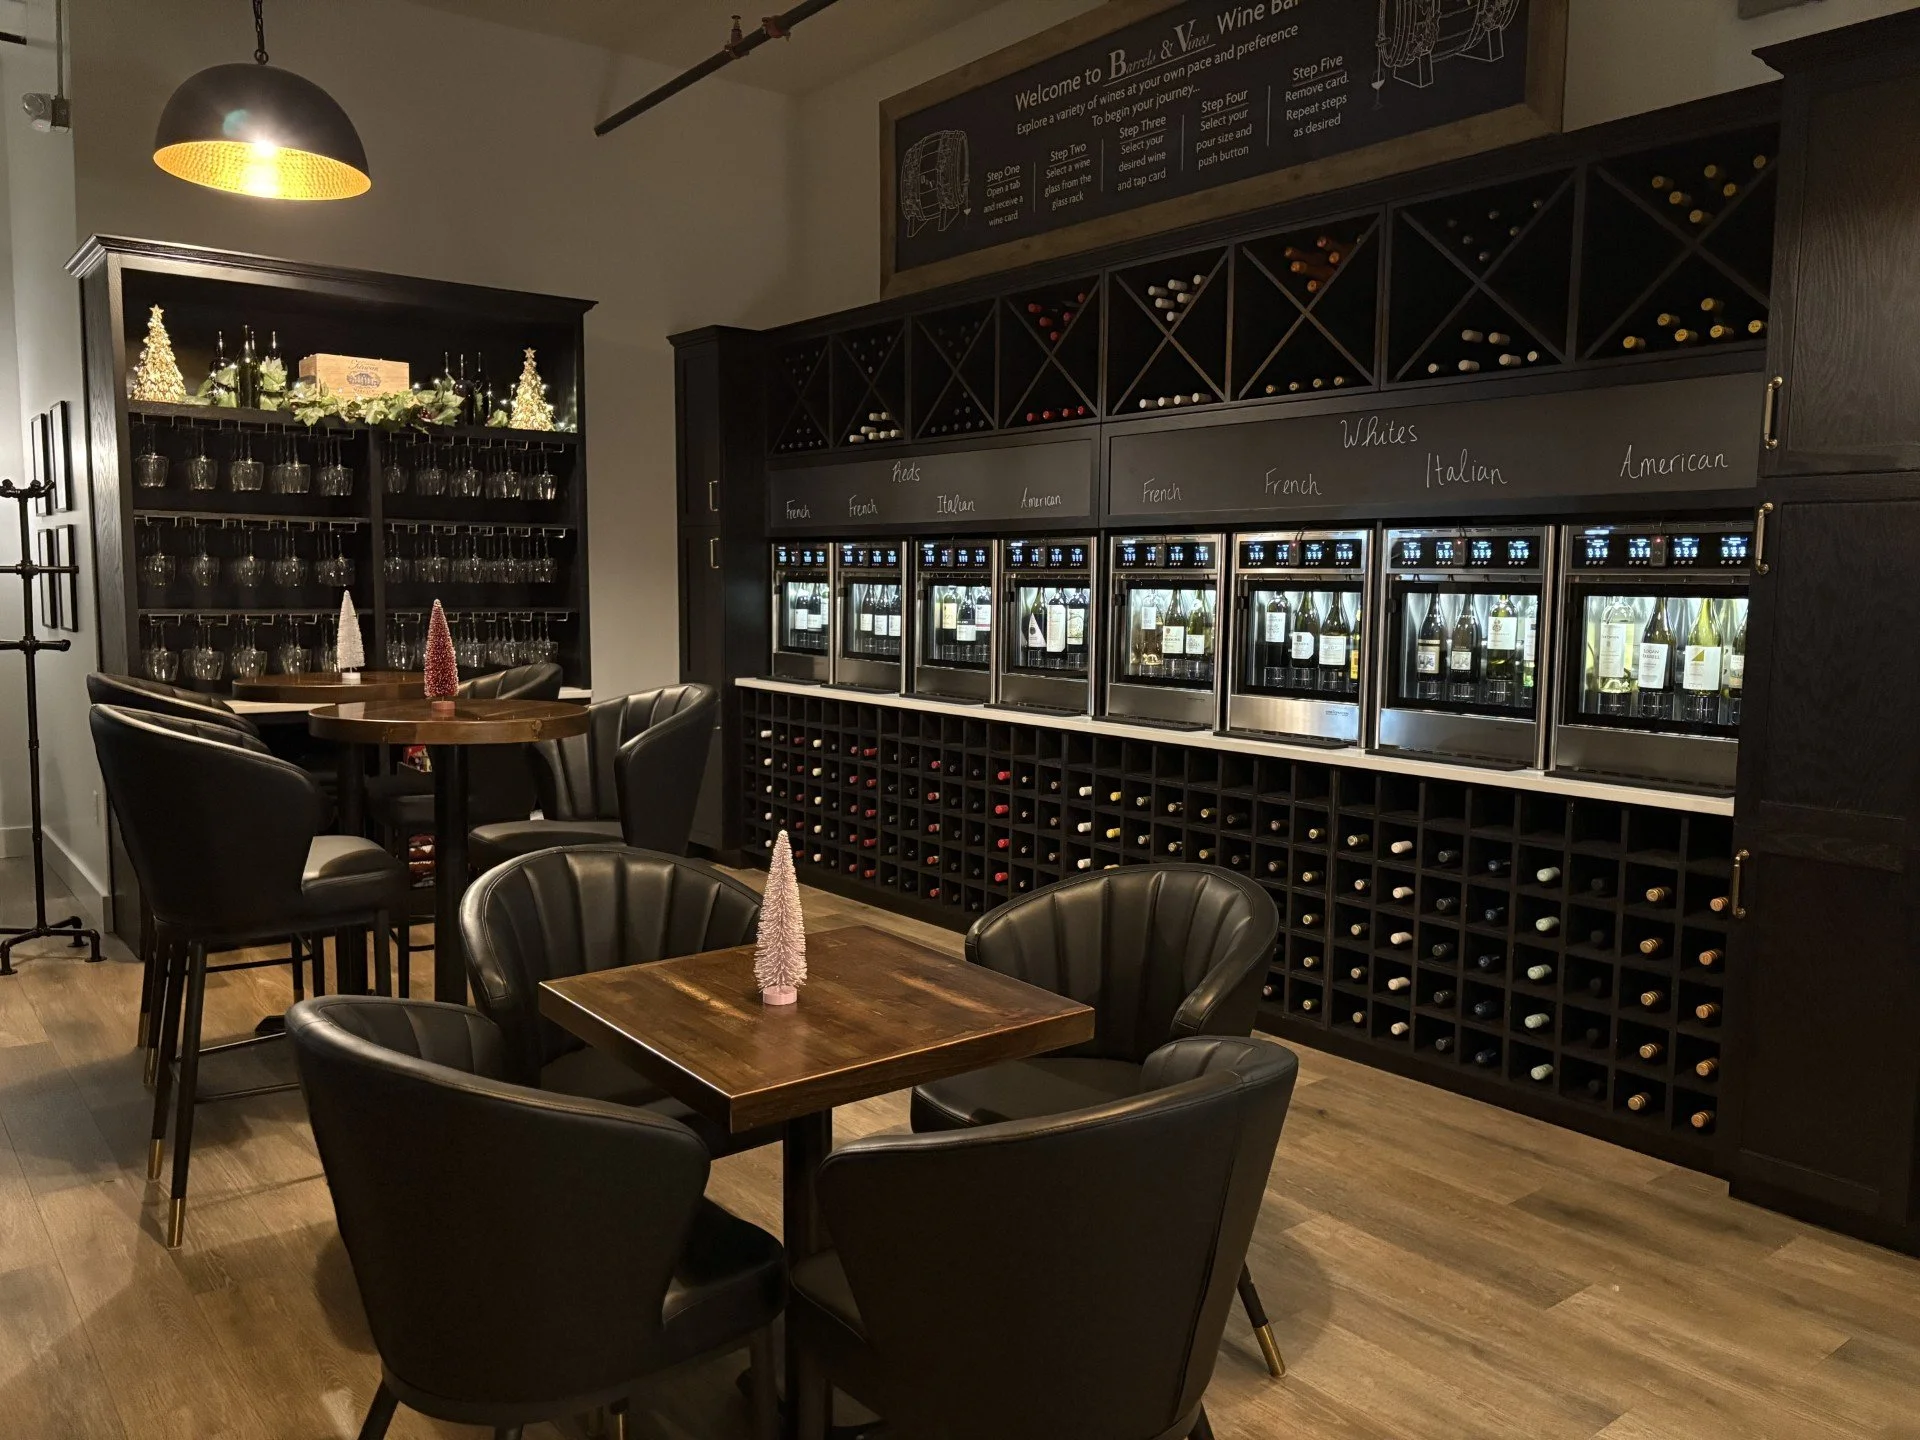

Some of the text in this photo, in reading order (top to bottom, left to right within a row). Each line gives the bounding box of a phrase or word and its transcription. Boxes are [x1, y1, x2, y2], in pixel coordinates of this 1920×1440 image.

[1015, 75, 1081, 112] Welcome
[1084, 68, 1102, 86] to
[1107, 49, 1156, 80] Barrels
[1160, 39, 1175, 60] &
[1173, 20, 1210, 53] Vines
[1216, 4, 1265, 35] Wine
[1293, 54, 1343, 81] Step Five
[1017, 25, 1299, 136] Explore a variety of wines at your own pace and preference
[1285, 70, 1350, 103] Remove card.
[1092, 84, 1200, 127] To begin your journey...
[1201, 89, 1249, 113] Step Four
[1286, 94, 1347, 122] Repeat steps
[1119, 116, 1167, 139] Step Three
[1200, 108, 1248, 132] Select your
[1293, 112, 1341, 138] as desired
[1121, 135, 1164, 155] Select your
[1196, 123, 1252, 155] pour size and
[1050, 143, 1087, 162] Step Two
[1119, 151, 1167, 172] desired wine
[1198, 146, 1249, 171] push button
[987, 164, 1020, 182] Step One
[1046, 158, 1091, 179] Select a wine
[1117, 167, 1166, 191] and tap card
[986, 179, 1020, 199] Open a tab
[1044, 174, 1092, 198] glass from the
[983, 195, 1023, 213] and receive a
[1052, 190, 1084, 211] glass rack
[989, 209, 1018, 226] wine card
[1340, 415, 1419, 448] Whites
[891, 459, 921, 483] Reds
[1425, 447, 1507, 488] Italian
[1620, 444, 1729, 479] American
[1142, 479, 1182, 503] French
[1265, 467, 1323, 497] French
[786, 499, 811, 520] French
[848, 494, 878, 518] French
[936, 494, 976, 515] Italian
[1020, 487, 1062, 509] American
